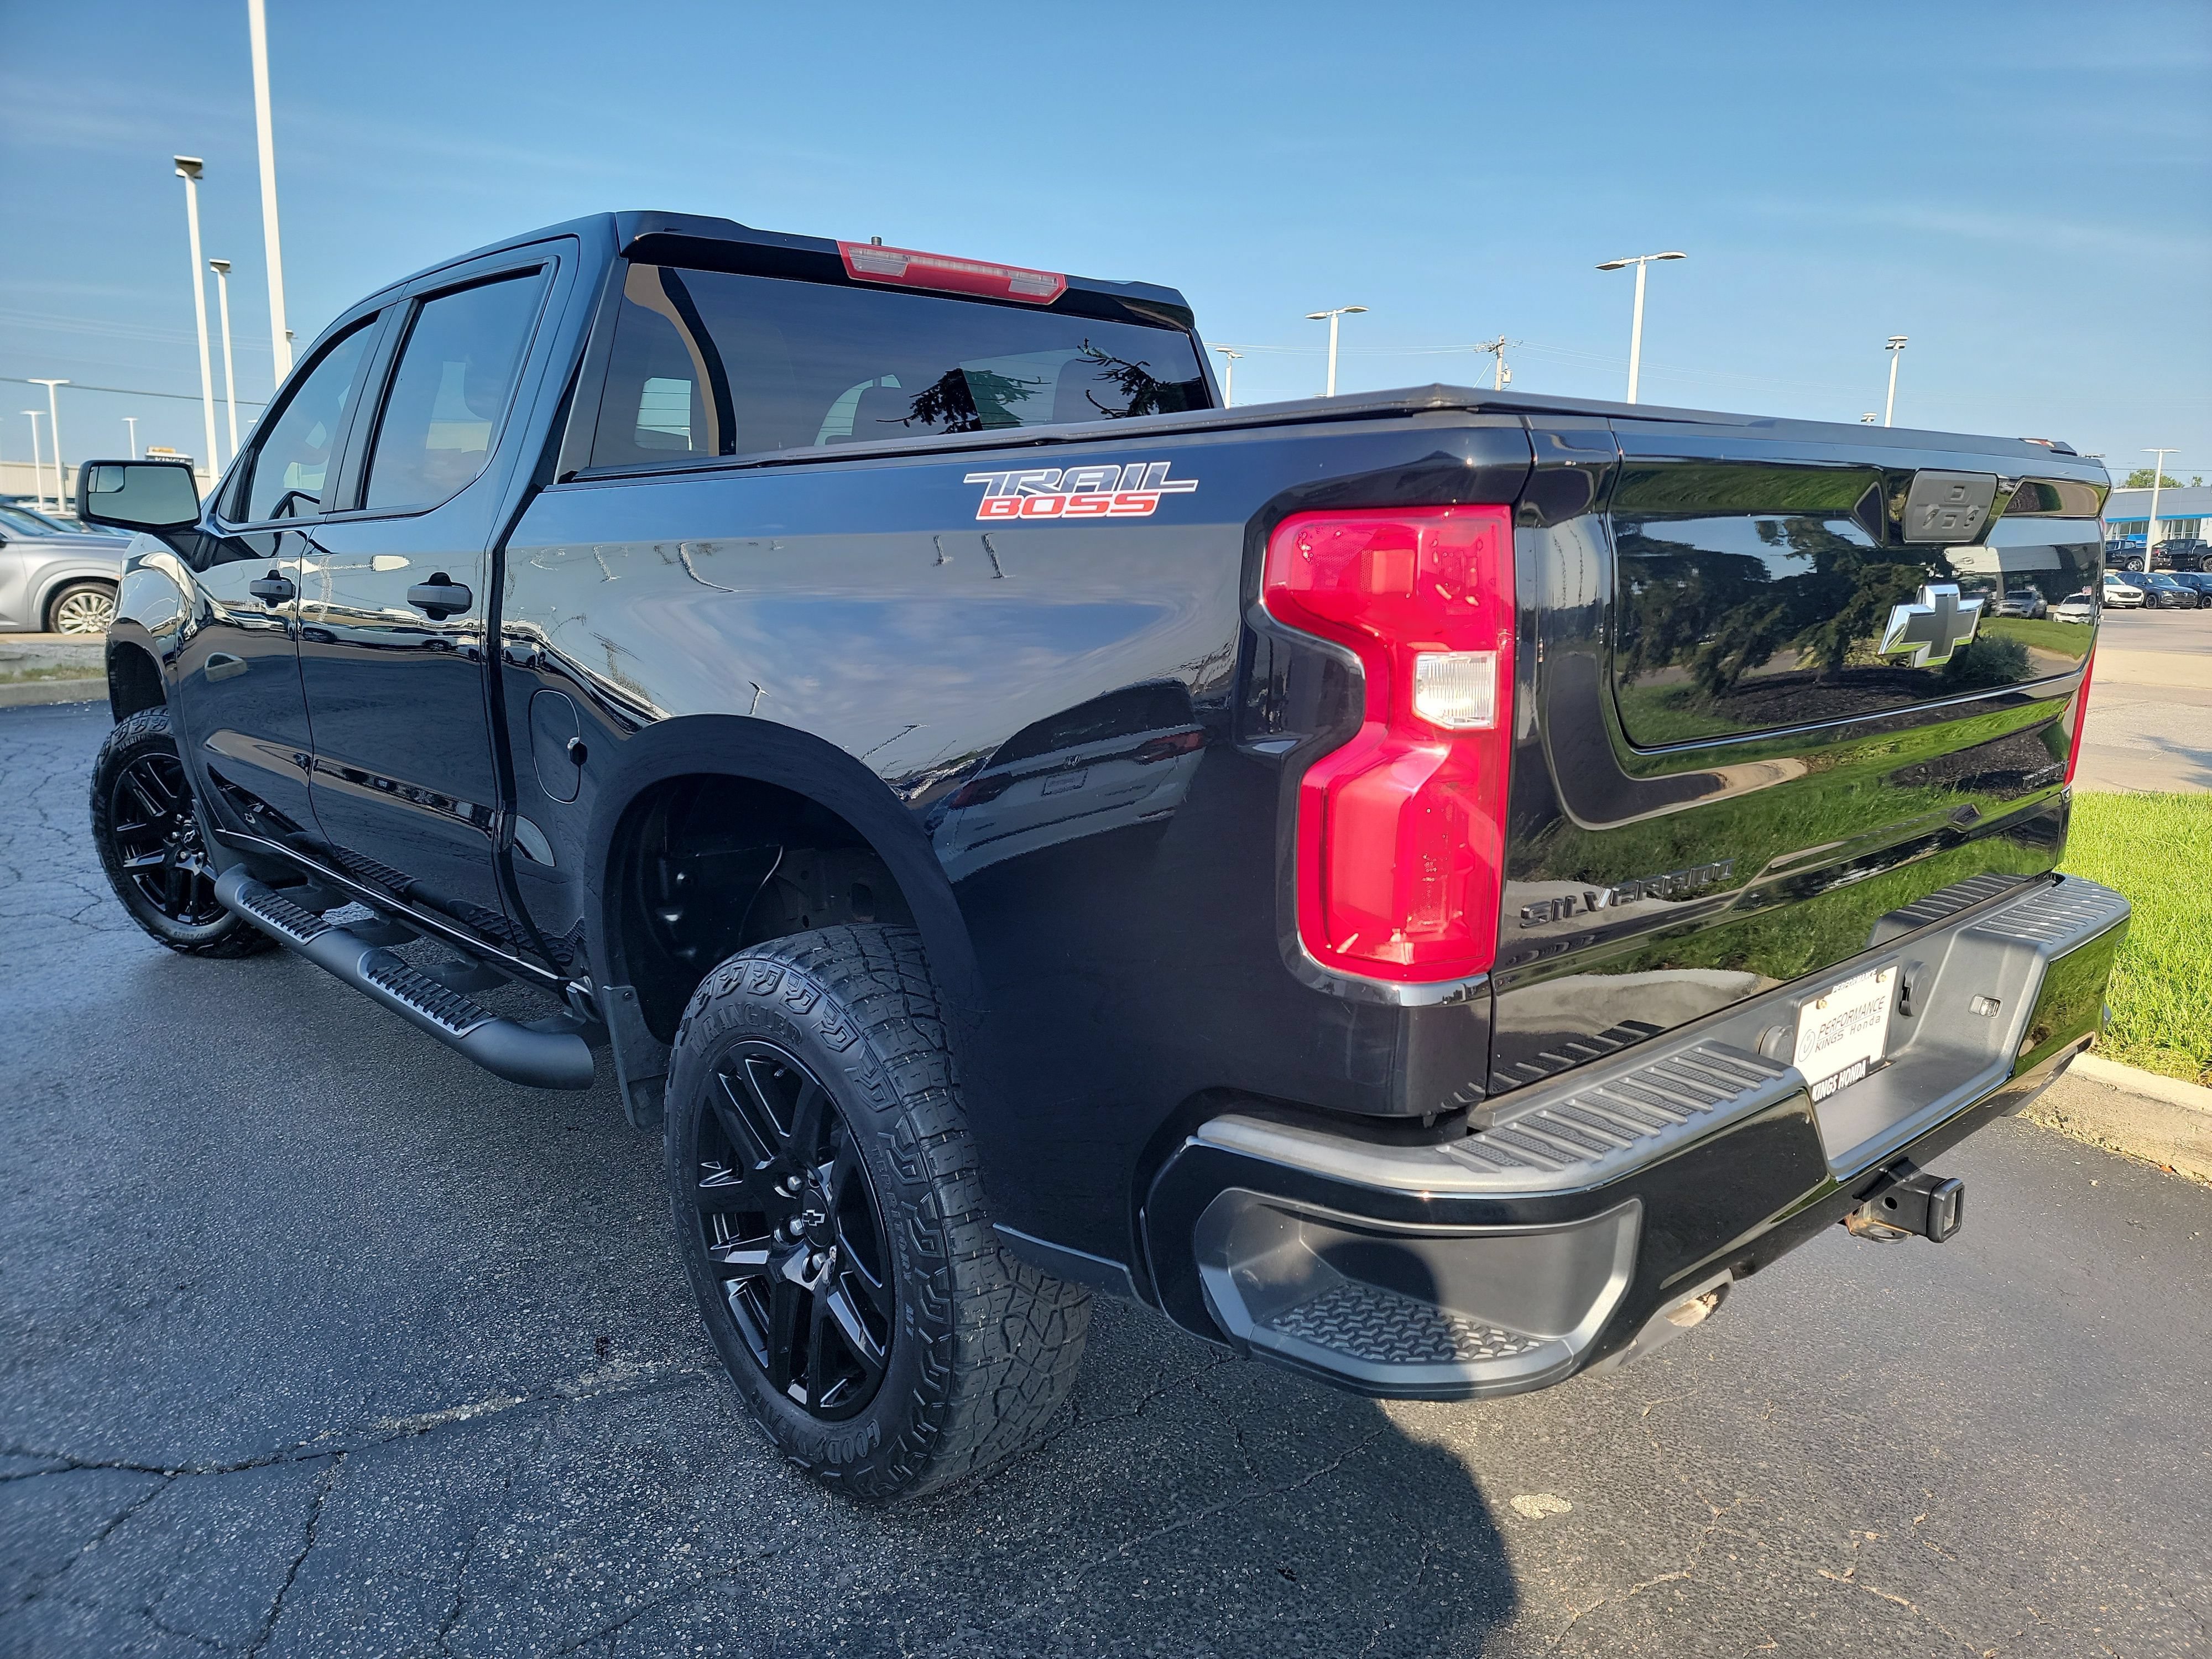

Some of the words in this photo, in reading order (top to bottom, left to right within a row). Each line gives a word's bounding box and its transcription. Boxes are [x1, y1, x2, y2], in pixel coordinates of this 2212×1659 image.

[963, 461, 1199, 497] TRAIL
[975, 491, 1162, 520] BOSS
[1519, 858, 1735, 929] SILVERADO
[1831, 968, 1877, 993] PERFORMANCE
[690, 1002, 803, 1058] WRANGLER
[1815, 1029, 1844, 1053] KINGS
[1850, 1015, 1881, 1035] Honda
[1818, 996, 1886, 1039] PERFORMANCE
[1812, 1075, 1839, 1102] KINGS
[1838, 1060, 1867, 1090] HONDA
[871, 1144, 912, 1286] TERRITORY
[750, 1389, 881, 1464] GOODYEAR
